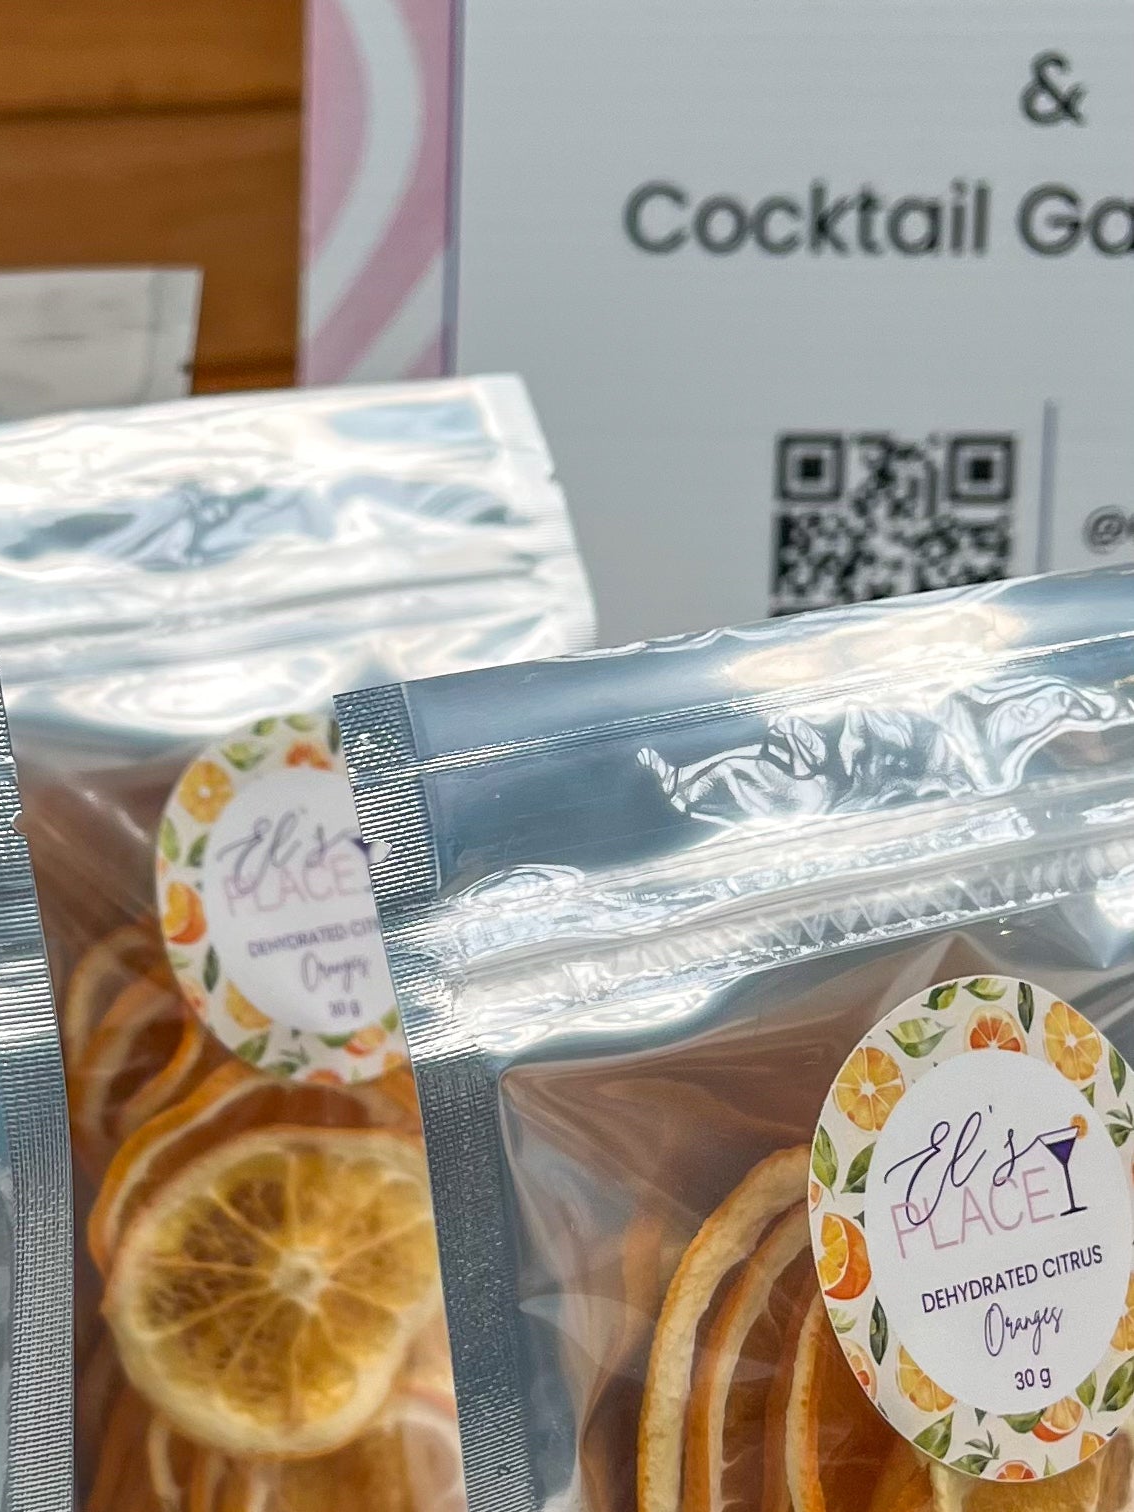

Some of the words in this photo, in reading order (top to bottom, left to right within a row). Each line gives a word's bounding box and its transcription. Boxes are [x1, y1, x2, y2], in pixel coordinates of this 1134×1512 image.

[1019, 49, 1087, 127] &
[622, 178, 991, 258] Cocktail
[223, 853, 355, 917] PLACE
[248, 923, 347, 958] DEHYDRATED
[890, 1166, 1055, 1260] PLACE
[921, 1263, 1038, 1313] DEHYDRATED
[1042, 1244, 1104, 1278] CITRUS
[984, 1302, 1064, 1357] Oranges
[1014, 1370, 1036, 1390] 30
[1039, 1367, 1053, 1390] g
